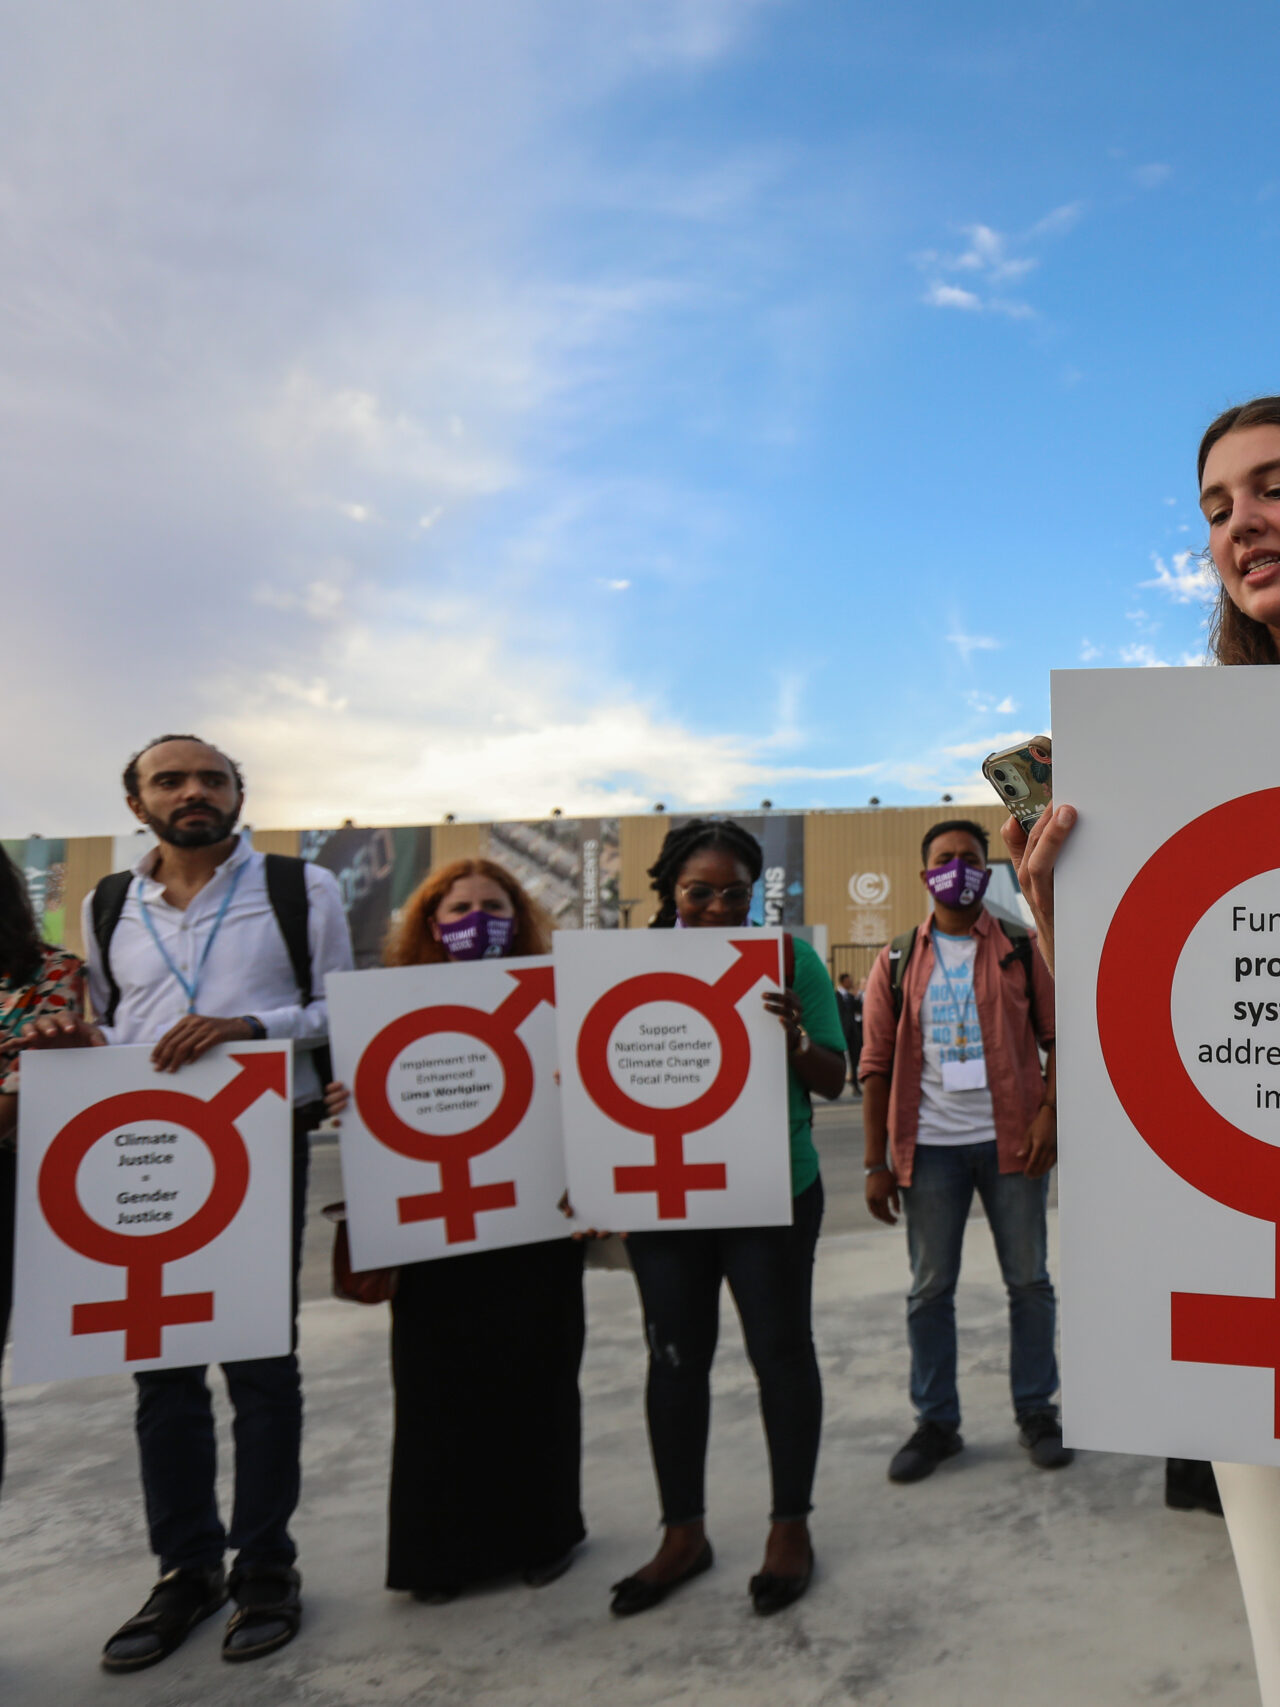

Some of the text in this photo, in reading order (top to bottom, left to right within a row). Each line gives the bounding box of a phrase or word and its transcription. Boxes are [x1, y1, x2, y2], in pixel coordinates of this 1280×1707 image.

[639, 1024, 687, 1037] Support
[615, 1040, 712, 1053] National Gender
[400, 1053, 486, 1071] Implement the
[618, 1057, 710, 1069] Climate Change
[416, 1069, 474, 1084] Enhanced
[630, 1073, 700, 1085] Focal Points
[416, 1099, 479, 1115] on Gender
[115, 1133, 178, 1147] Climate
[117, 1152, 174, 1167] Justice
[116, 1189, 179, 1205] Gender
[116, 1209, 173, 1225] Justice
